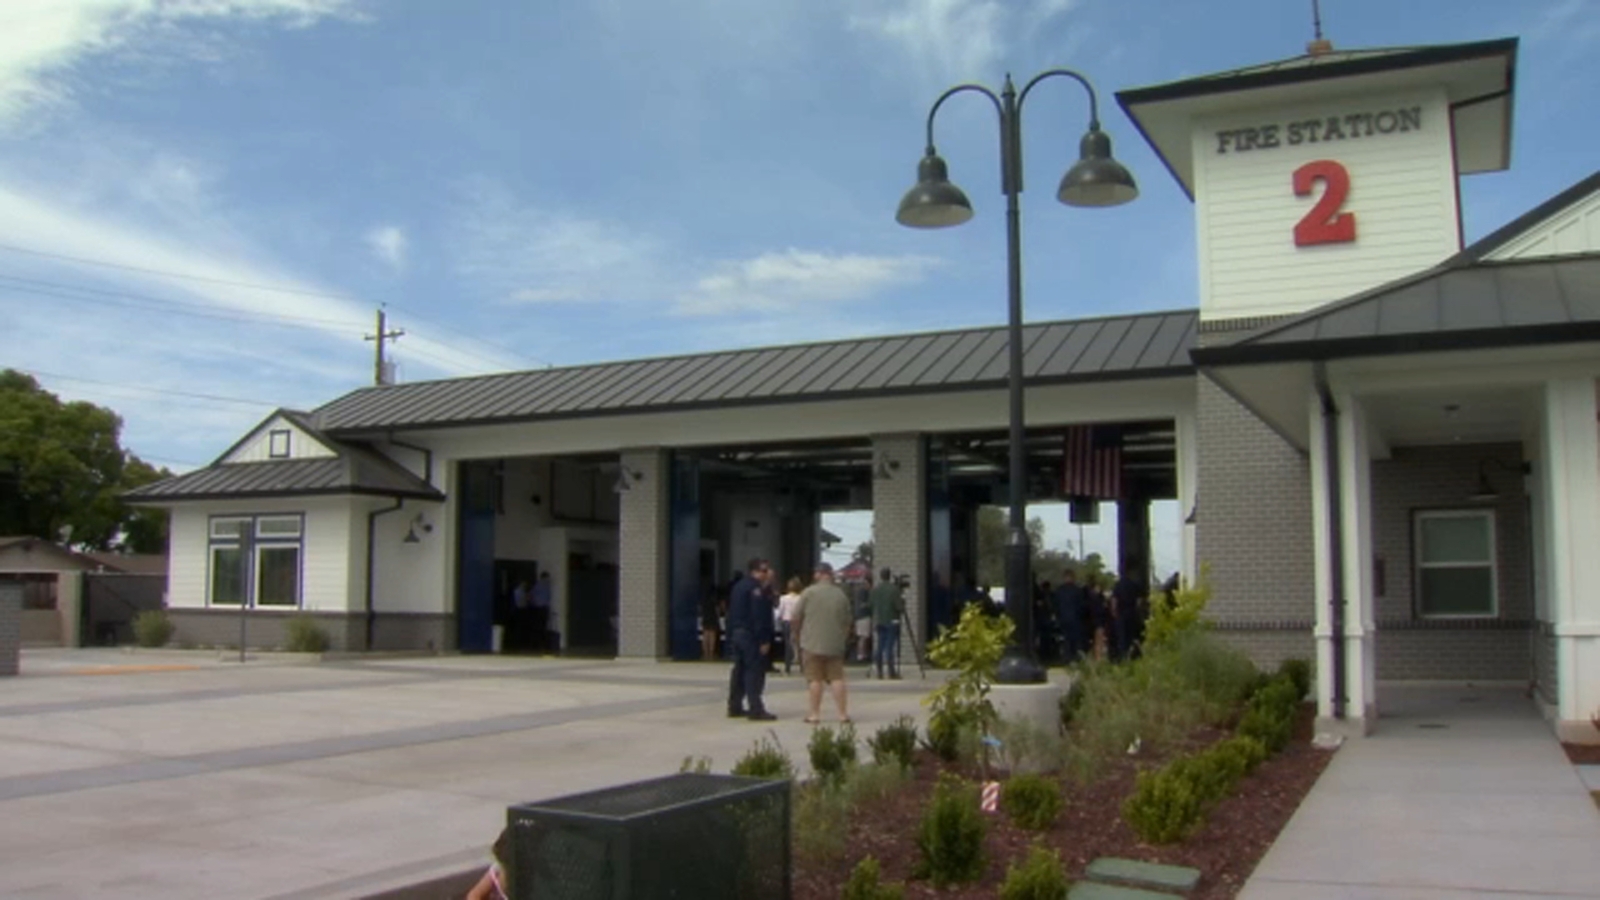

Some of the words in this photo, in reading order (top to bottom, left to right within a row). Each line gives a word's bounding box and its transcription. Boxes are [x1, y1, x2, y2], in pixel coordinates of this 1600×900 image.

[1216, 124, 1280, 153] FIRE
[1287, 107, 1421, 146] STATION
[1292, 160, 1356, 247] 2
